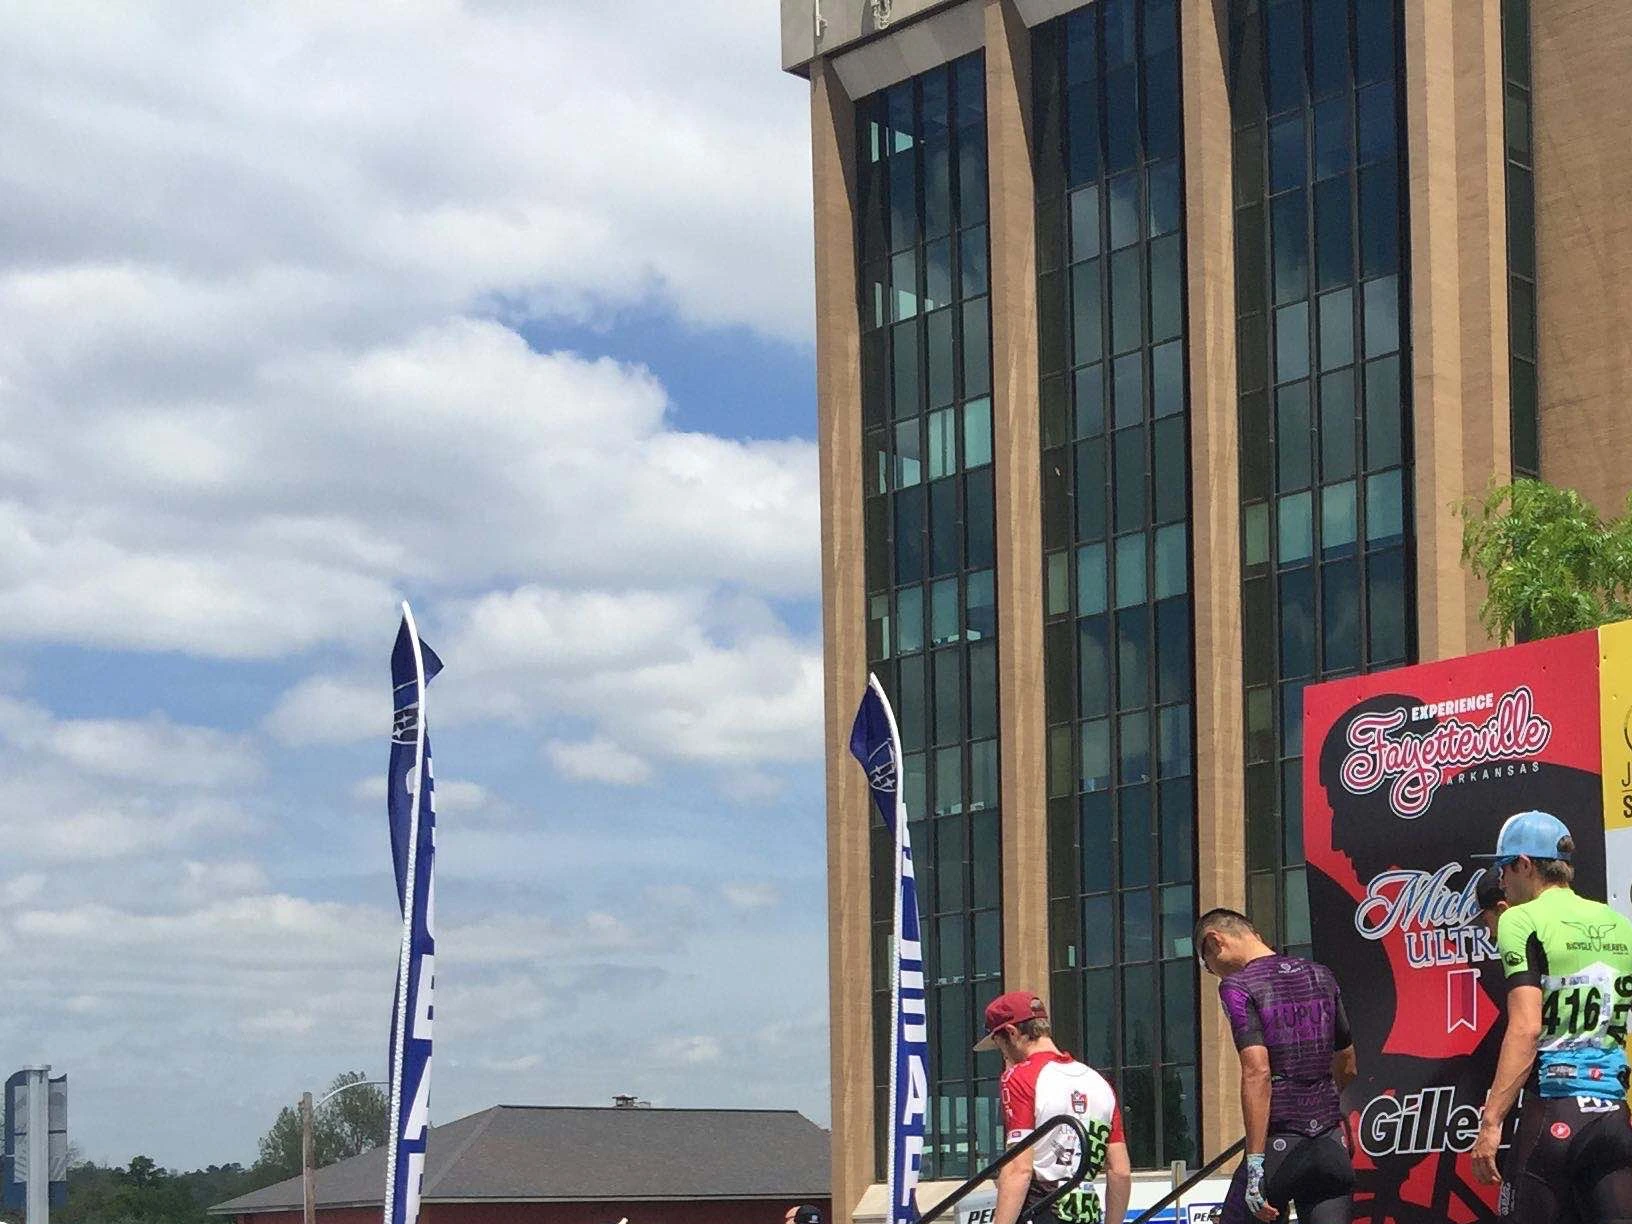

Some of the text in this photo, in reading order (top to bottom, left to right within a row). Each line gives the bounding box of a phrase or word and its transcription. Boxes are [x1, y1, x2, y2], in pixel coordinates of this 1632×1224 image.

[1412, 693, 1493, 721] EXPERIENCE
[1340, 684, 1551, 819] Fayetteville
[1447, 761, 1540, 785] ARKANSAS
[1405, 925, 1500, 969] ULTR
[1542, 987, 1601, 1036] 416
